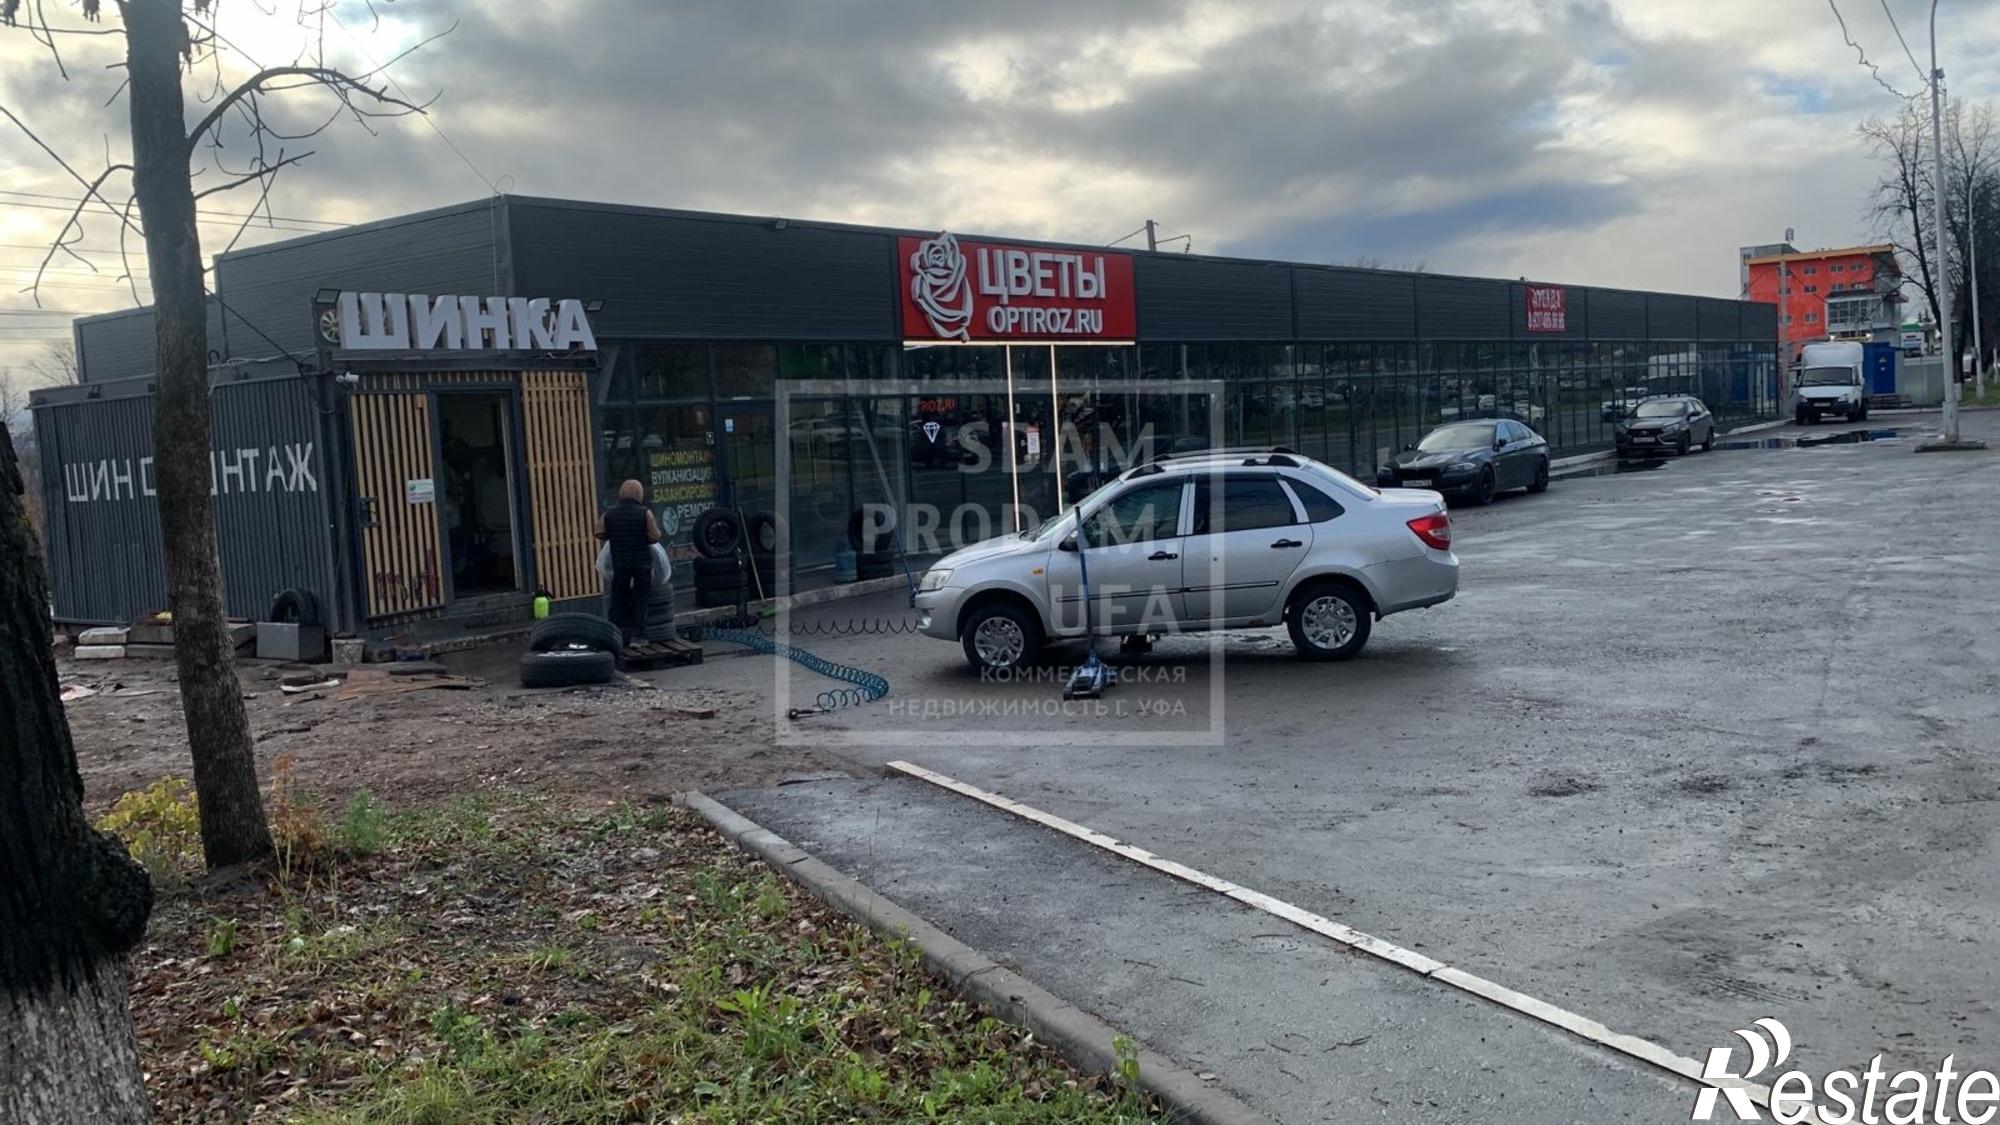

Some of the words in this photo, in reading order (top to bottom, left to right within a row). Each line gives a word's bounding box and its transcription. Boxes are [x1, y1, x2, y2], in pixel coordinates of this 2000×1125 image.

[977, 248, 1106, 304] ЦВЕТЫ
[336, 291, 598, 350] ШИНКА
[986, 306, 1103, 334] OPTROZ.RU
[64, 441, 318, 502] ШИНОНТАЖ
